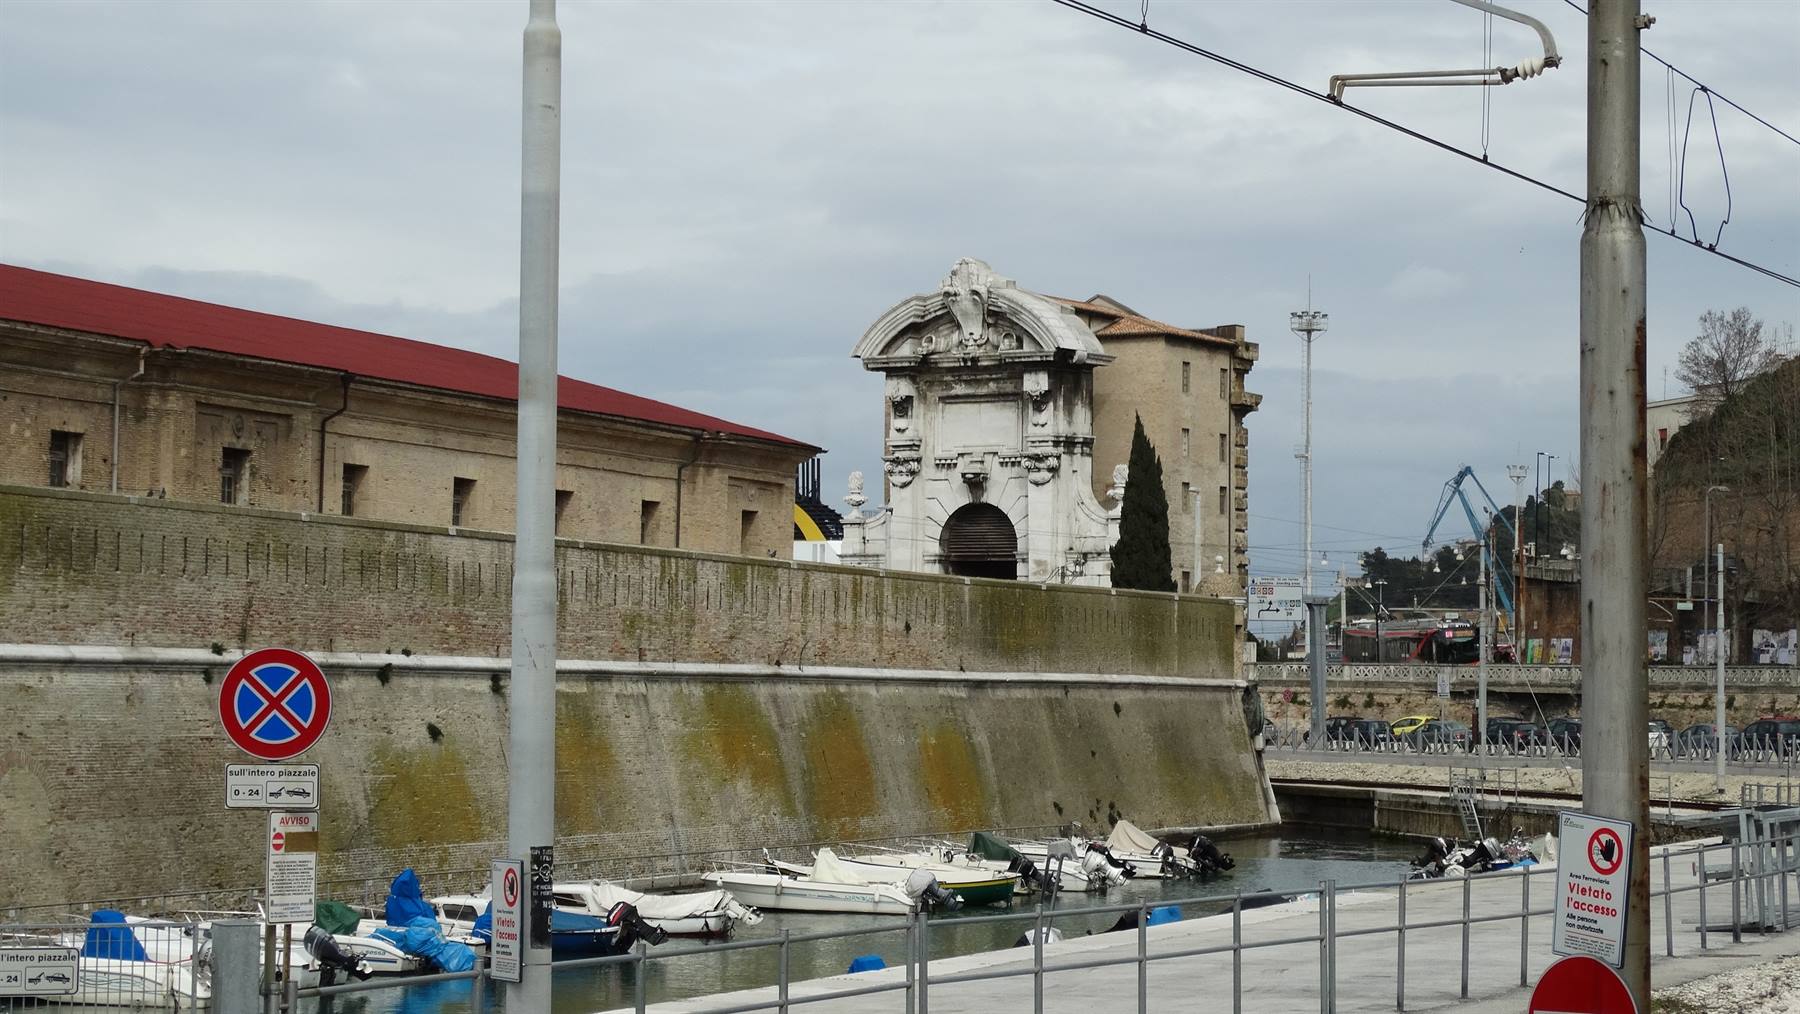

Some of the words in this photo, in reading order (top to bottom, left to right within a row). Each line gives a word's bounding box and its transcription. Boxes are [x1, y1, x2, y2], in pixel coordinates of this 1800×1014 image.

[229, 768, 275, 777] sull'intero
[278, 768, 316, 778] piazzale
[280, 816, 310, 825] AVVISO
[1569, 872, 1582, 880] Area
[1568, 881, 1612, 901] Vietato
[1567, 896, 1617, 917] l'accesso
[38, 953, 76, 963] piazzale
[6, 975, 18, 983] 24
